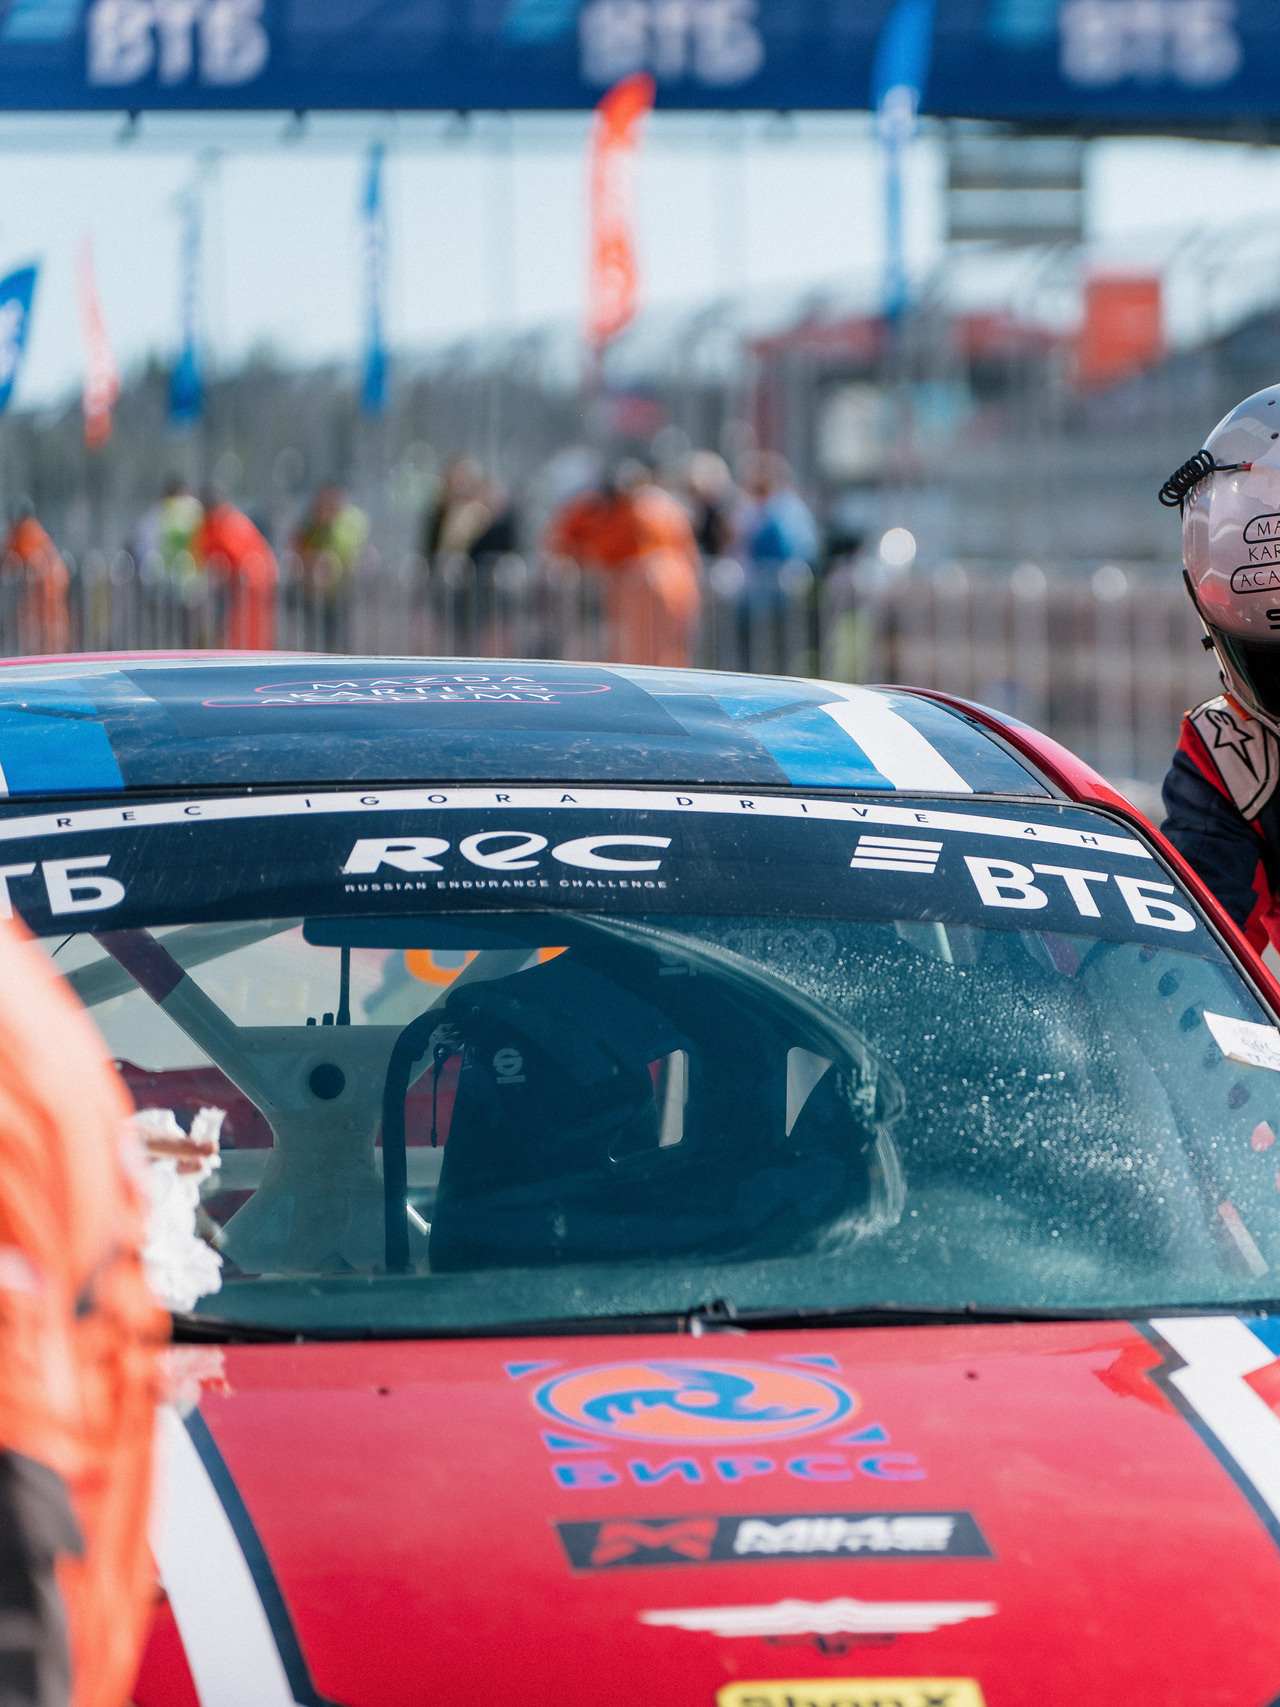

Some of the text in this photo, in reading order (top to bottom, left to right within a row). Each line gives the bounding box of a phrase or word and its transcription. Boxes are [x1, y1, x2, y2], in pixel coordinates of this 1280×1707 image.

[312, 675, 536, 690] MAZDA
[289, 684, 550, 699] KARTING
[56, 805, 202, 828] REC
[304, 793, 579, 809] IGORA
[675, 796, 930, 824] DRIVE
[344, 878, 668, 893] RUSSIAN ENDURANCE CHALLENGE
[963, 855, 1198, 933] ВТБ
